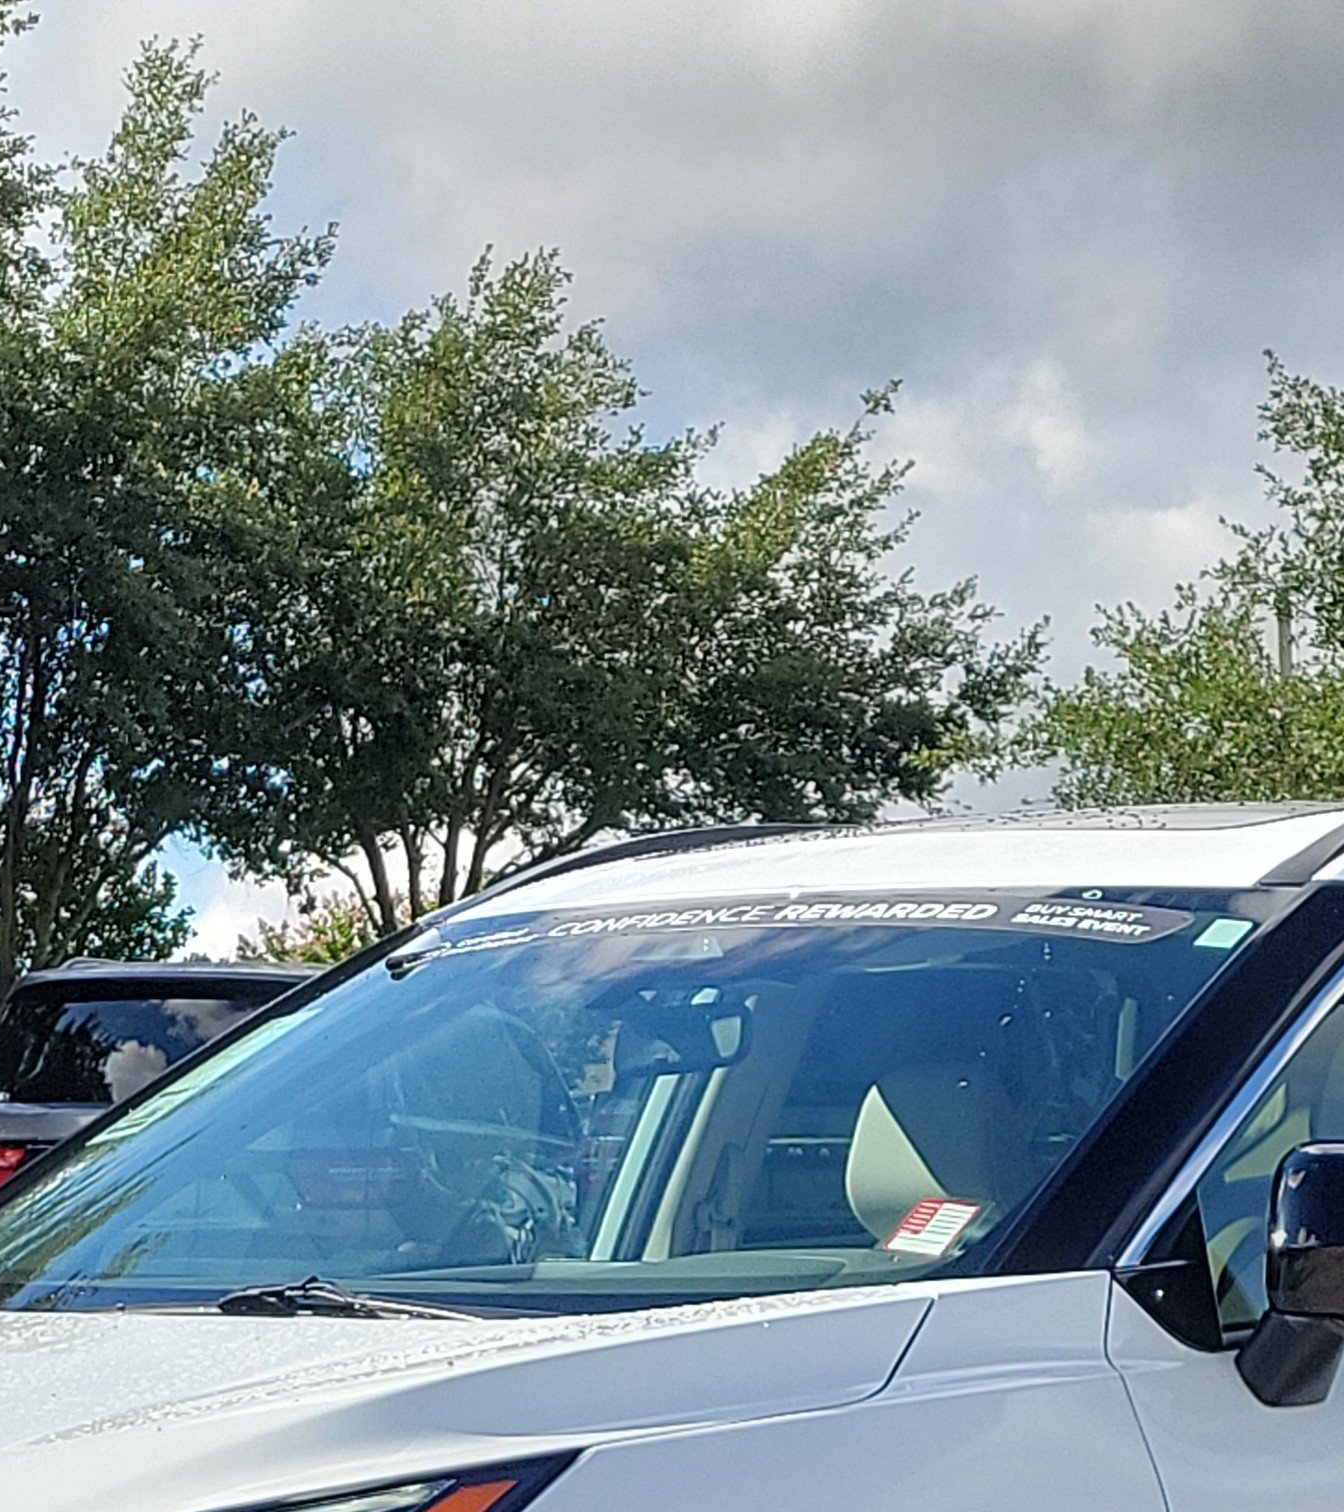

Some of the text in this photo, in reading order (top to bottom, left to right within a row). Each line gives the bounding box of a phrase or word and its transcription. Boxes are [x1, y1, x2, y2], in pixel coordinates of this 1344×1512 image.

[546, 905, 776, 938] CONFIDENCE
[775, 902, 999, 921] REWARDED
[1025, 903, 1143, 922] BUY SMART
[1010, 913, 1151, 936] SALES EVENT
